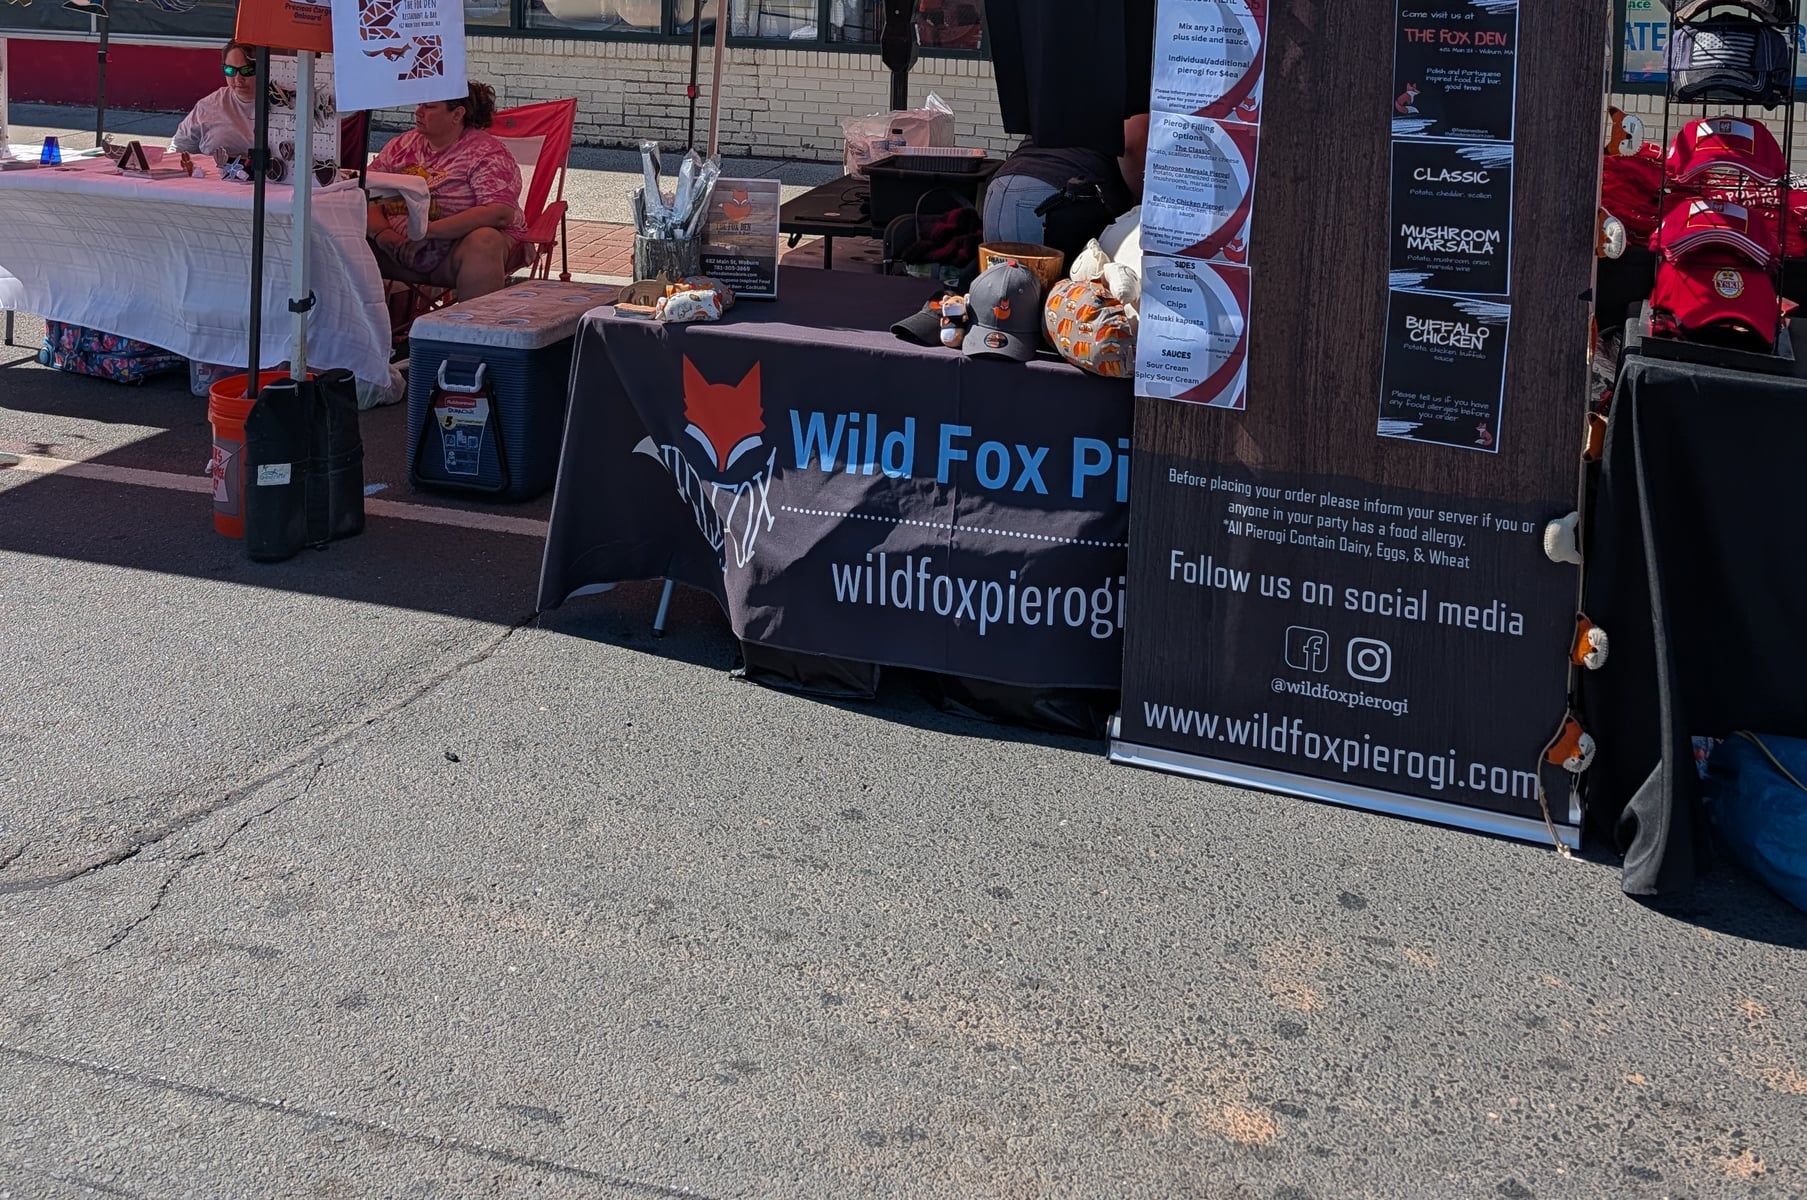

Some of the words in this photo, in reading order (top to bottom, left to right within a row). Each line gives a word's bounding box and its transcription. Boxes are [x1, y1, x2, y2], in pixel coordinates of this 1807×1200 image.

[1402, 10, 1427, 18] Come
[1430, 11, 1448, 19] visit
[1179, 22, 1192, 30] Mix
[1217, 26, 1244, 35] pierogi
[1173, 33, 1189, 42] plus
[1191, 34, 1207, 42] side
[1209, 35, 1224, 43] and
[1404, 28, 1436, 43] THE
[1440, 29, 1470, 45] FOX
[1475, 31, 1507, 46] DEN
[1168, 54, 1250, 68] Individual/additional
[1177, 67, 1205, 76] pierogi
[1220, 70, 1238, 78] $4ea
[1163, 119, 1189, 130] Pierogi
[1191, 122, 1215, 133] Filling
[1173, 132, 1203, 141] Options
[1175, 145, 1188, 153] The
[1414, 168, 1490, 184] CLASSIC
[1400, 224, 1500, 243] MUSHROOM
[1407, 237, 1494, 255] MARSALA
[1175, 261, 1196, 269] SIDES
[1157, 270, 1196, 280] Sauerkraut
[1160, 284, 1192, 293] Coleslaw
[1166, 301, 1187, 309] Chips
[1148, 313, 1173, 322] Haluski
[1176, 316, 1204, 326] kapusta
[1406, 315, 1490, 338] BUFFALO
[1410, 329, 1484, 350] CHICKEN
[1161, 349, 1192, 359] SAUCES
[1146, 361, 1163, 369] Sour
[1165, 364, 1189, 372] Cream
[1136, 371, 1155, 380] Spicy
[1156, 373, 1173, 382] Sour
[1175, 376, 1199, 384] Cream
[1406, 400, 1425, 409] food
[1461, 408, 1490, 418] before
[1454, 399, 1468, 408] you
[1470, 400, 1489, 409] have
[1418, 411, 1433, 420] you
[1435, 414, 1459, 422] order
[789, 409, 916, 480] Wild
[936, 423, 1050, 495] Fox
[1071, 436, 1130, 503] Pi
[1168, 468, 1206, 488] Before
[1210, 475, 1252, 497] placing
[1256, 484, 1281, 502] your
[1284, 488, 1316, 505] order
[1320, 491, 1360, 511] please
[1364, 498, 1404, 516] inform
[1407, 506, 1434, 522] your
[1438, 510, 1478, 526] server
[1482, 512, 1491, 528] if
[1495, 516, 1518, 533] you
[1521, 520, 1535, 534] or
[1228, 502, 1269, 521] anyone
[1273, 506, 1284, 521] in
[1287, 511, 1313, 527] your
[1316, 513, 1349, 532] party
[1352, 517, 1374, 534] has
[1378, 523, 1386, 536] a
[1389, 522, 1418, 540] food
[1421, 527, 1467, 548] allergy.
[1246, 523, 1286, 544] Pierogi
[1290, 530, 1336, 549] Contain
[1339, 536, 1373, 558] Dairy,
[1376, 542, 1410, 562] Eggs,
[1412, 548, 1425, 562] &
[1428, 550, 1470, 569] Wheat
[832, 552, 1126, 639] wildfoxpierogi
[1169, 549, 1250, 593] Follow
[1260, 574, 1291, 599] us
[1302, 580, 1333, 606] on
[1344, 587, 1427, 622] social
[1438, 600, 1524, 636] media
[1271, 677, 1409, 716] @wildfoxpierogi
[1143, 700, 1540, 801] www.wildfoxpierogi.com
